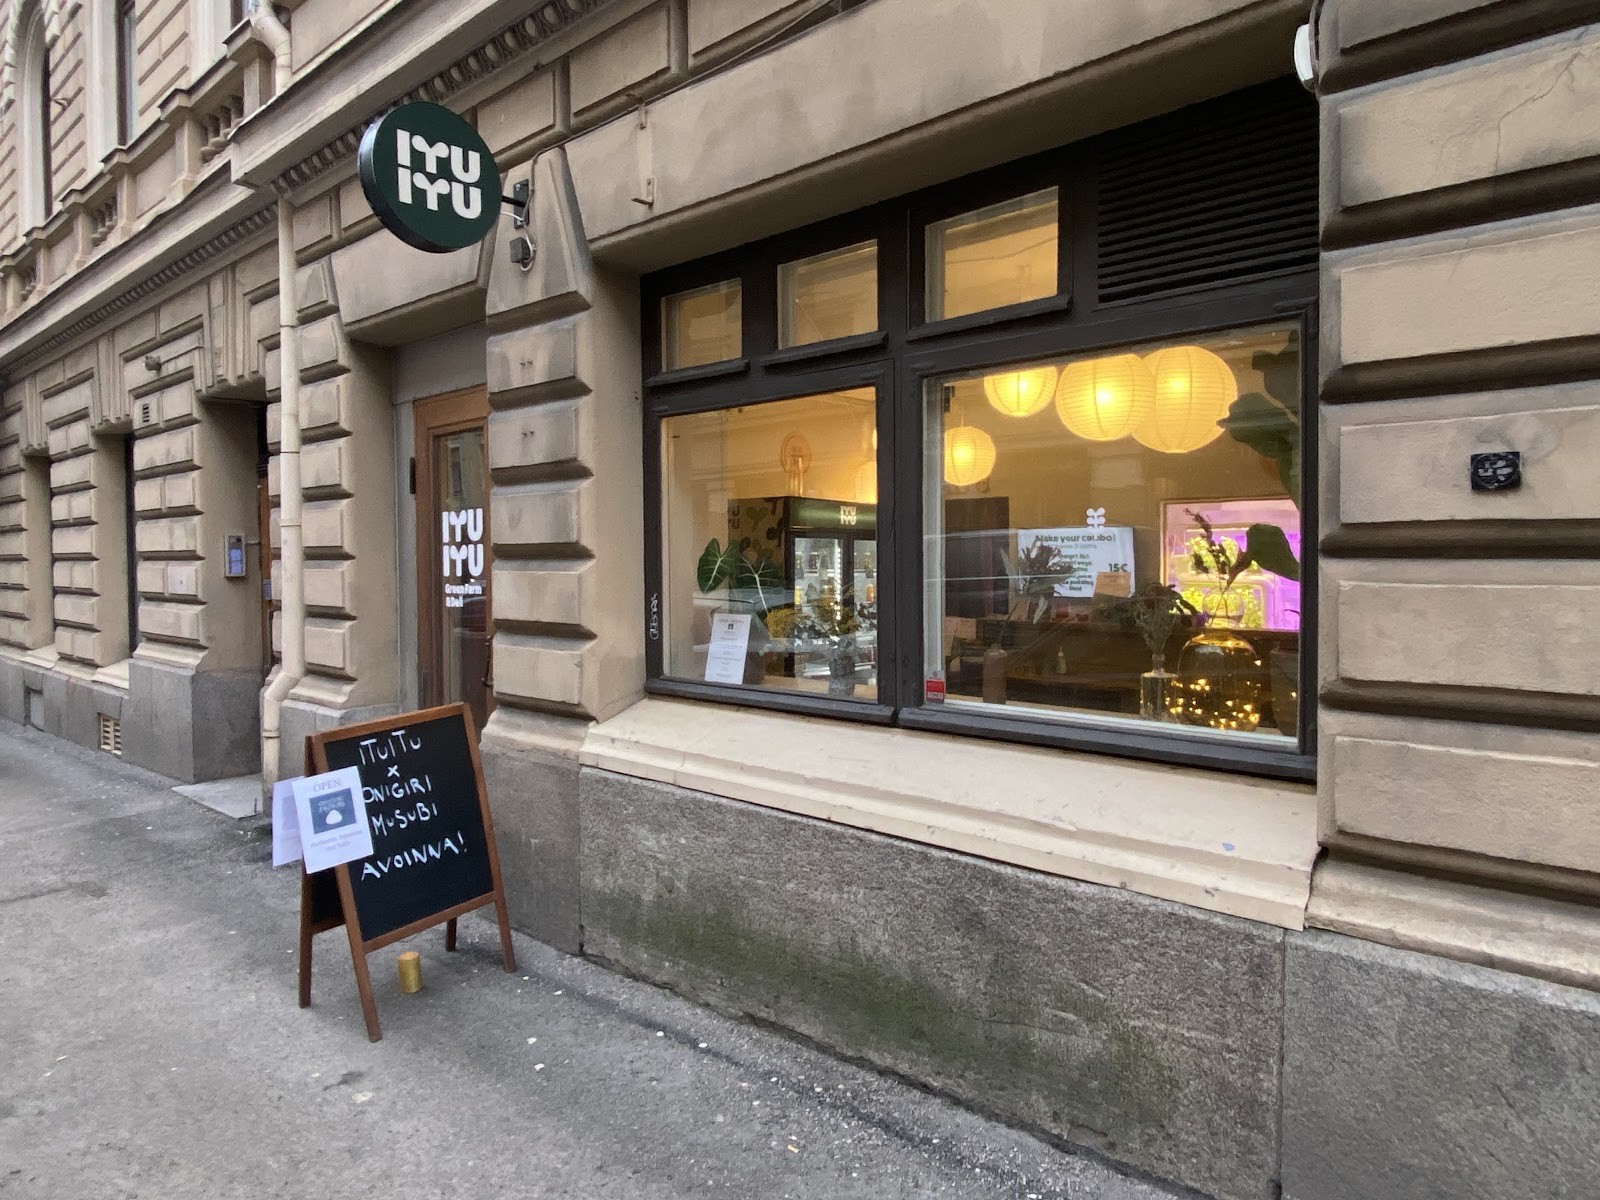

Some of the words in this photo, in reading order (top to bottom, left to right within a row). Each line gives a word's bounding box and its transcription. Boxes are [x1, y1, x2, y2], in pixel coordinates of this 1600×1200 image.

[313, 778, 343, 793] OPEN
[363, 775, 432, 803] ONIGIRI
[361, 831, 467, 881] AVOINNA!
